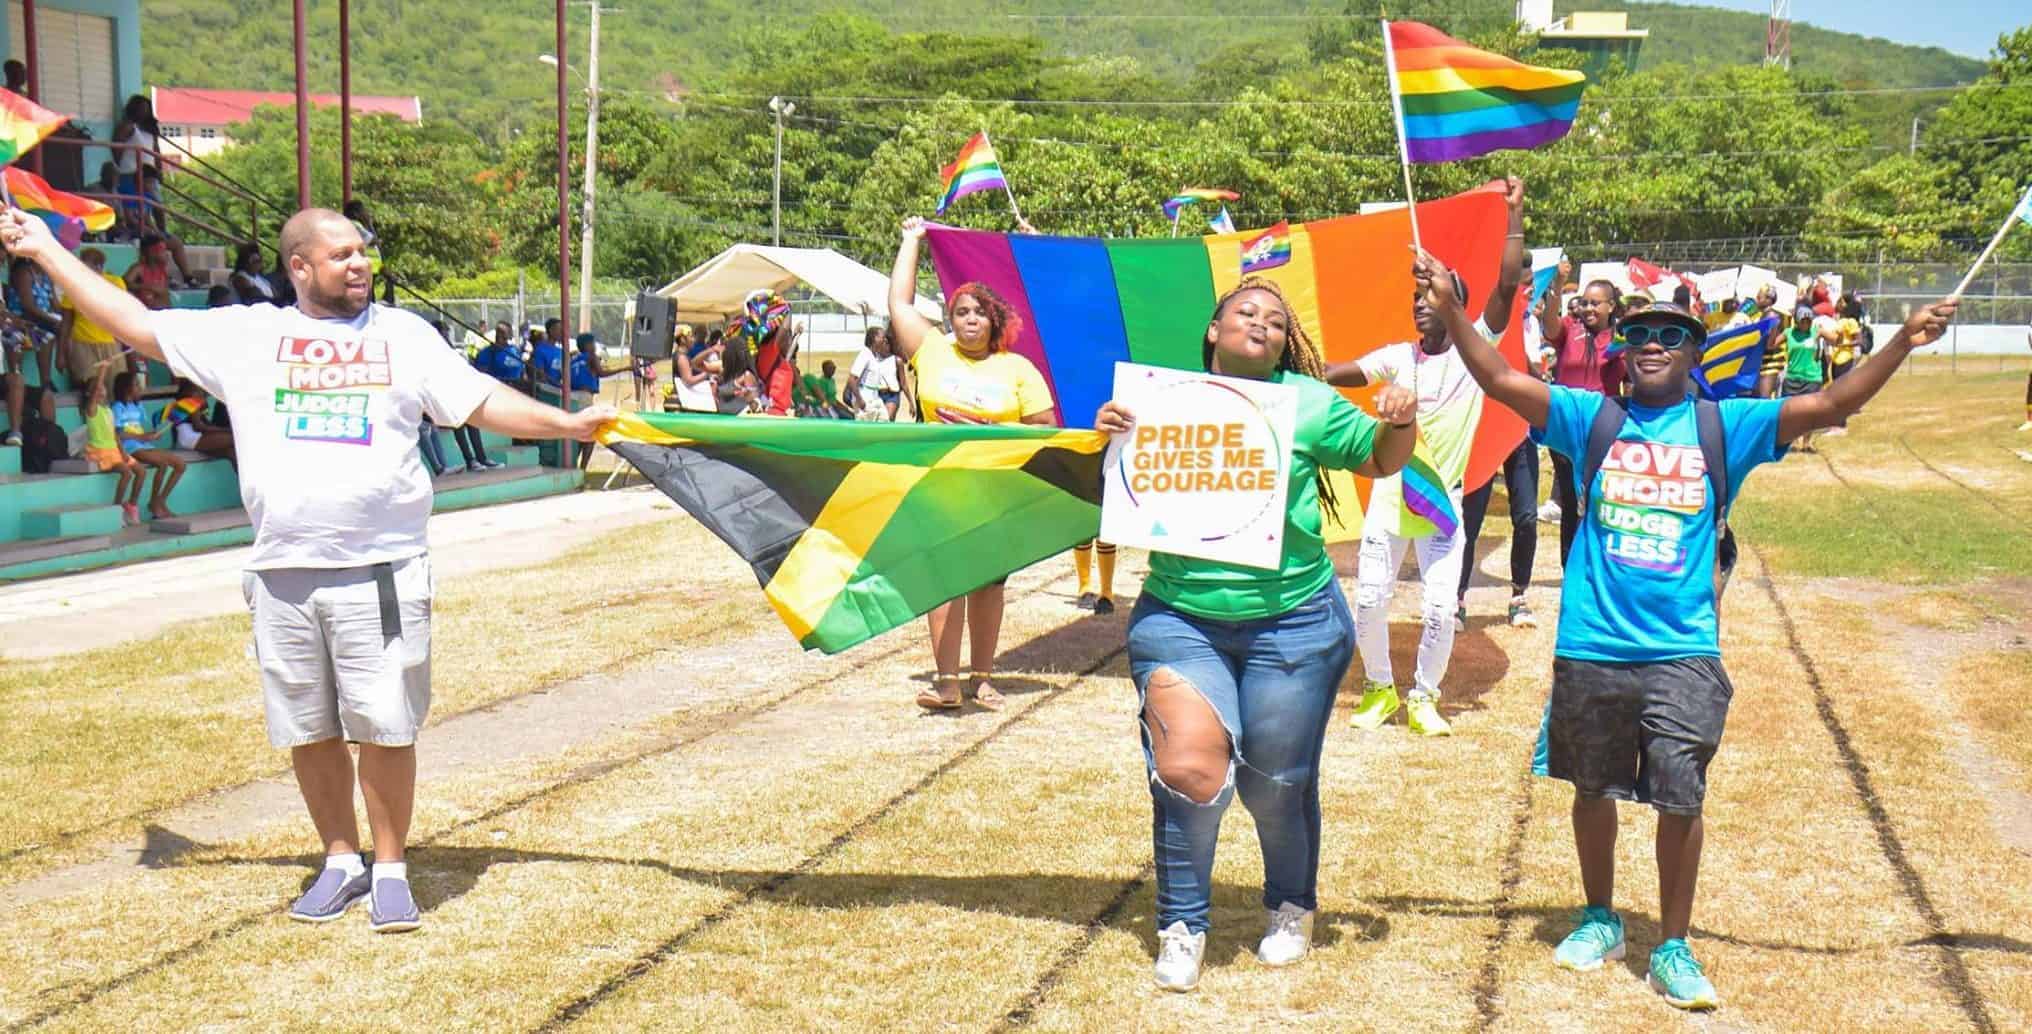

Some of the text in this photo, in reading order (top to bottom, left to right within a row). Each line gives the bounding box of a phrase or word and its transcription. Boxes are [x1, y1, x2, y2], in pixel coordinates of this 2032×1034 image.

[279, 337, 388, 364] LOVE
[290, 362, 391, 389] MORE
[276, 392, 366, 414] JUDGE
[287, 415, 365, 438] LESS
[1136, 423, 1245, 449] PRIDE
[1133, 448, 1265, 471] GIVES ME
[1601, 443, 1705, 479] LOVE
[1131, 470, 1277, 493] COURAGE
[1606, 475, 1705, 507] MORE
[1606, 533, 1679, 563] LESS
